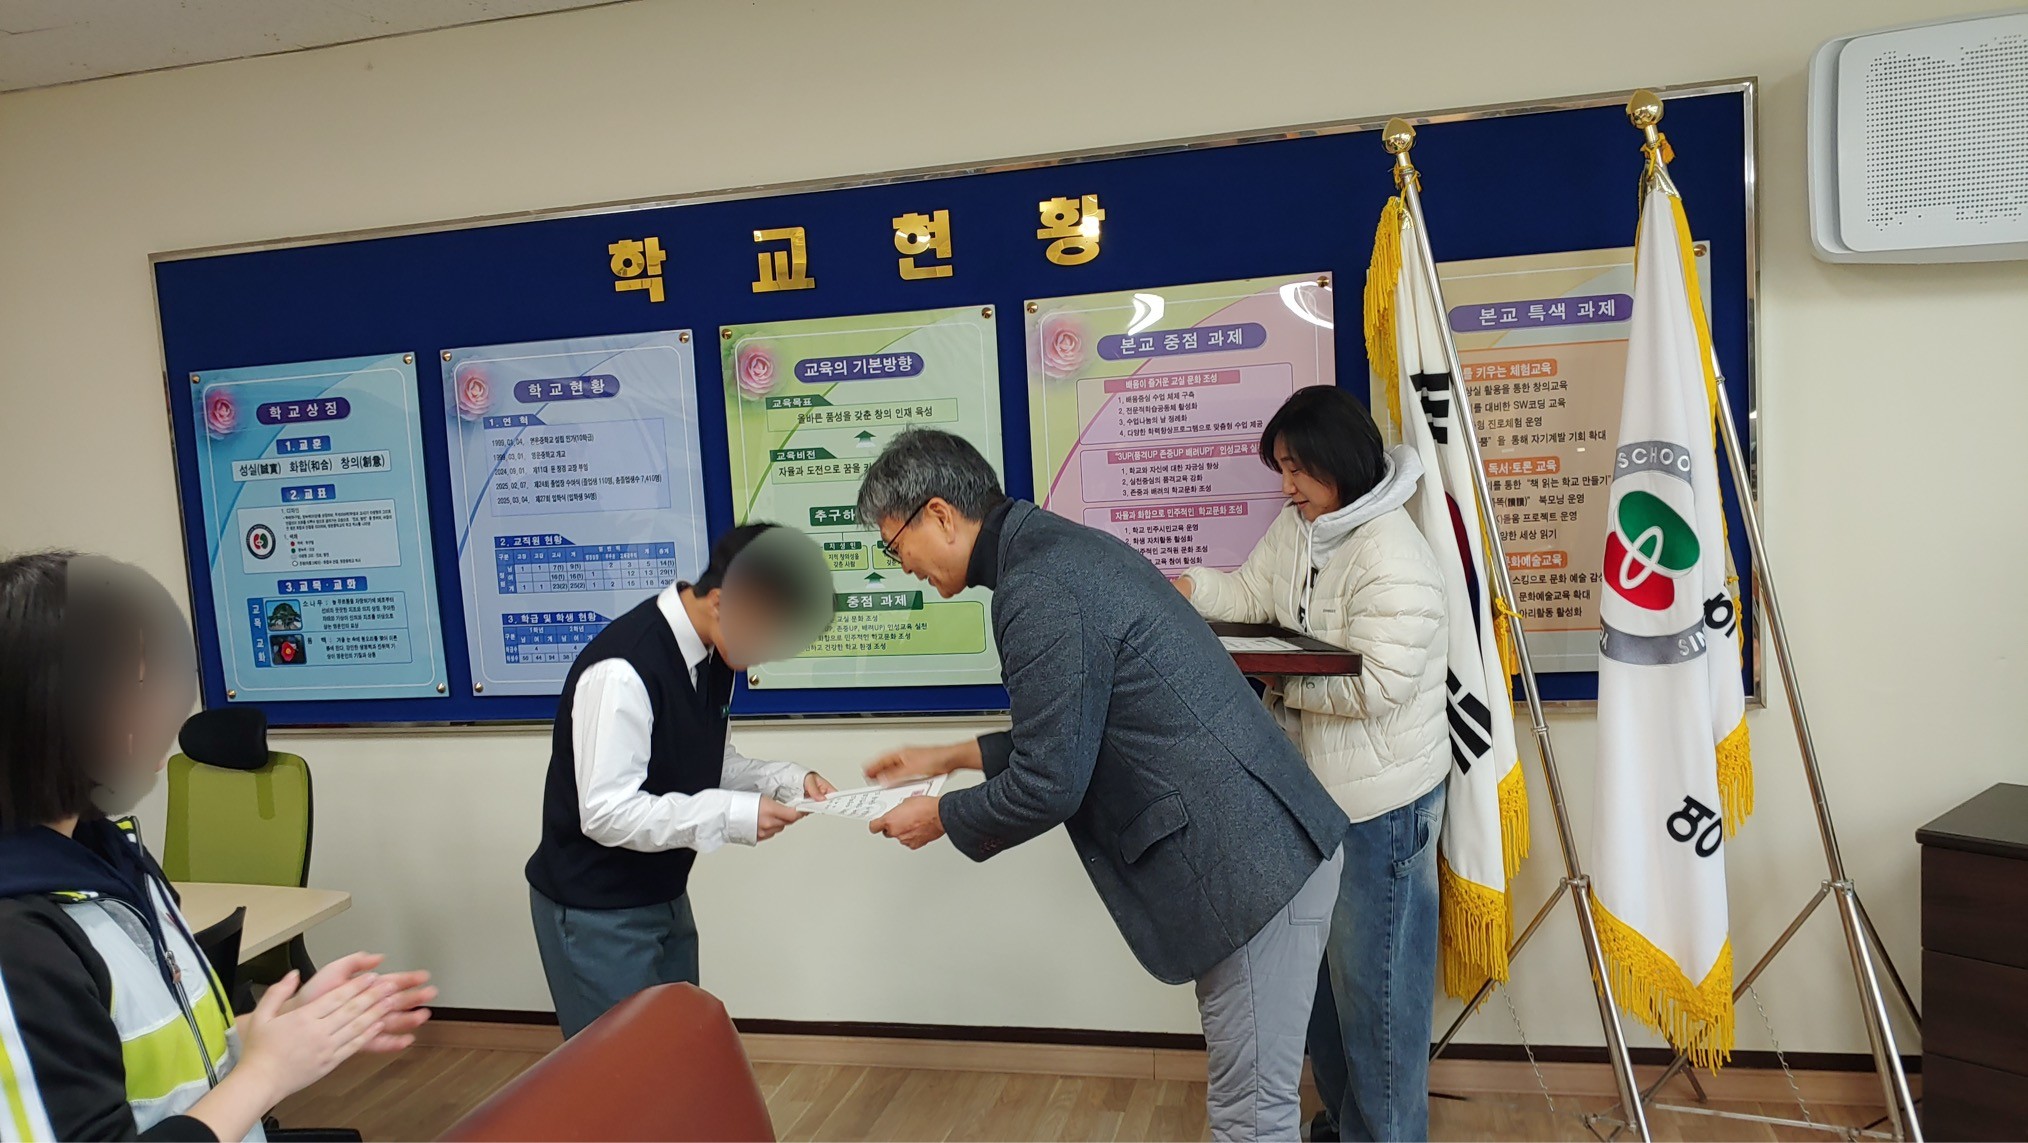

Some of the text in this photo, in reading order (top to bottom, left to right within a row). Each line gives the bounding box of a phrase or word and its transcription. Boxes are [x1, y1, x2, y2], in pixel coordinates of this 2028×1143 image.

[1479, 299, 1616, 326] 본교 특색 과제
[1120, 329, 1242, 354] 본교 중점 과제
[804, 356, 913, 377] 교육의 기본방향
[1476, 362, 1551, 379] 키우는 체험교육
[1126, 374, 1217, 389] 배움이 즐거운 교실 문화 조성
[528, 379, 604, 398] 학교현황
[1485, 381, 1568, 395] 활용을 통한 창의교육
[772, 398, 812, 408] 교육목표
[1152, 393, 1165, 401] 수업
[269, 402, 337, 419] 학교상징
[1178, 402, 1197, 411] 활성화
[1485, 398, 1566, 412] 대비한 SW코딩 교육
[797, 406, 933, 424] 올바른 품성을 갖춘 창의 인재 육성
[1127, 416, 1158, 425] 수업나눔의
[1127, 427, 1146, 437] 다양한
[1213, 421, 1232, 431] 맞춤형
[1235, 421, 1247, 429] 수업
[1250, 420, 1263, 428] 제공
[1488, 416, 1543, 430] 진로체험 운영
[1497, 429, 1607, 446] 을 통해 자기계발 기회 확대
[1220, 444, 1248, 454] 인성교육
[1250, 443, 1259, 452] 실
[776, 451, 816, 460] 교육비전
[779, 466, 803, 477] 자율과
[807, 465, 840, 475] 도전으로
[843, 463, 860, 474] 꿈을
[1130, 462, 1219, 474] 학교와 자신에 대한 자긍심 향상
[1488, 460, 1557, 474] 독서·토론 교육
[1163, 474, 1187, 483] 품격교육
[1190, 474, 1202, 482] 강화
[1505, 480, 1521, 490] 통한
[1542, 478, 1559, 488] 읽는
[1562, 477, 1579, 487] 학교
[1131, 488, 1148, 496] 존중과
[1151, 487, 1169, 495] 배려의
[1172, 485, 1196, 493] 학교문화
[1539, 493, 1585, 505] 북모닝 운영
[1116, 504, 1242, 520] 자율과 화합으로 민주적인 학교문화 조성
[1523, 511, 1577, 522] 프로젝트 운영
[1133, 526, 1144, 534] 학교
[1147, 524, 1184, 533] 민주시민교육
[1520, 529, 1536, 540] 세상
[1540, 529, 1557, 539] 읽기
[1133, 535, 1193, 545] 학생 자치활동 활성화
[1160, 546, 1178, 554] 교직원
[1195, 545, 1208, 553] 조성
[1169, 557, 1181, 565] 참여
[1184, 556, 1202, 564] 활성화
[1550, 574, 1567, 584] 문화
[1570, 573, 1586, 583] 예술
[847, 594, 907, 608] 중점 과제
[1519, 590, 1590, 602] 문화예술교육 확대
[1557, 607, 1582, 617] 활성화
[898, 632, 911, 640] 조성
